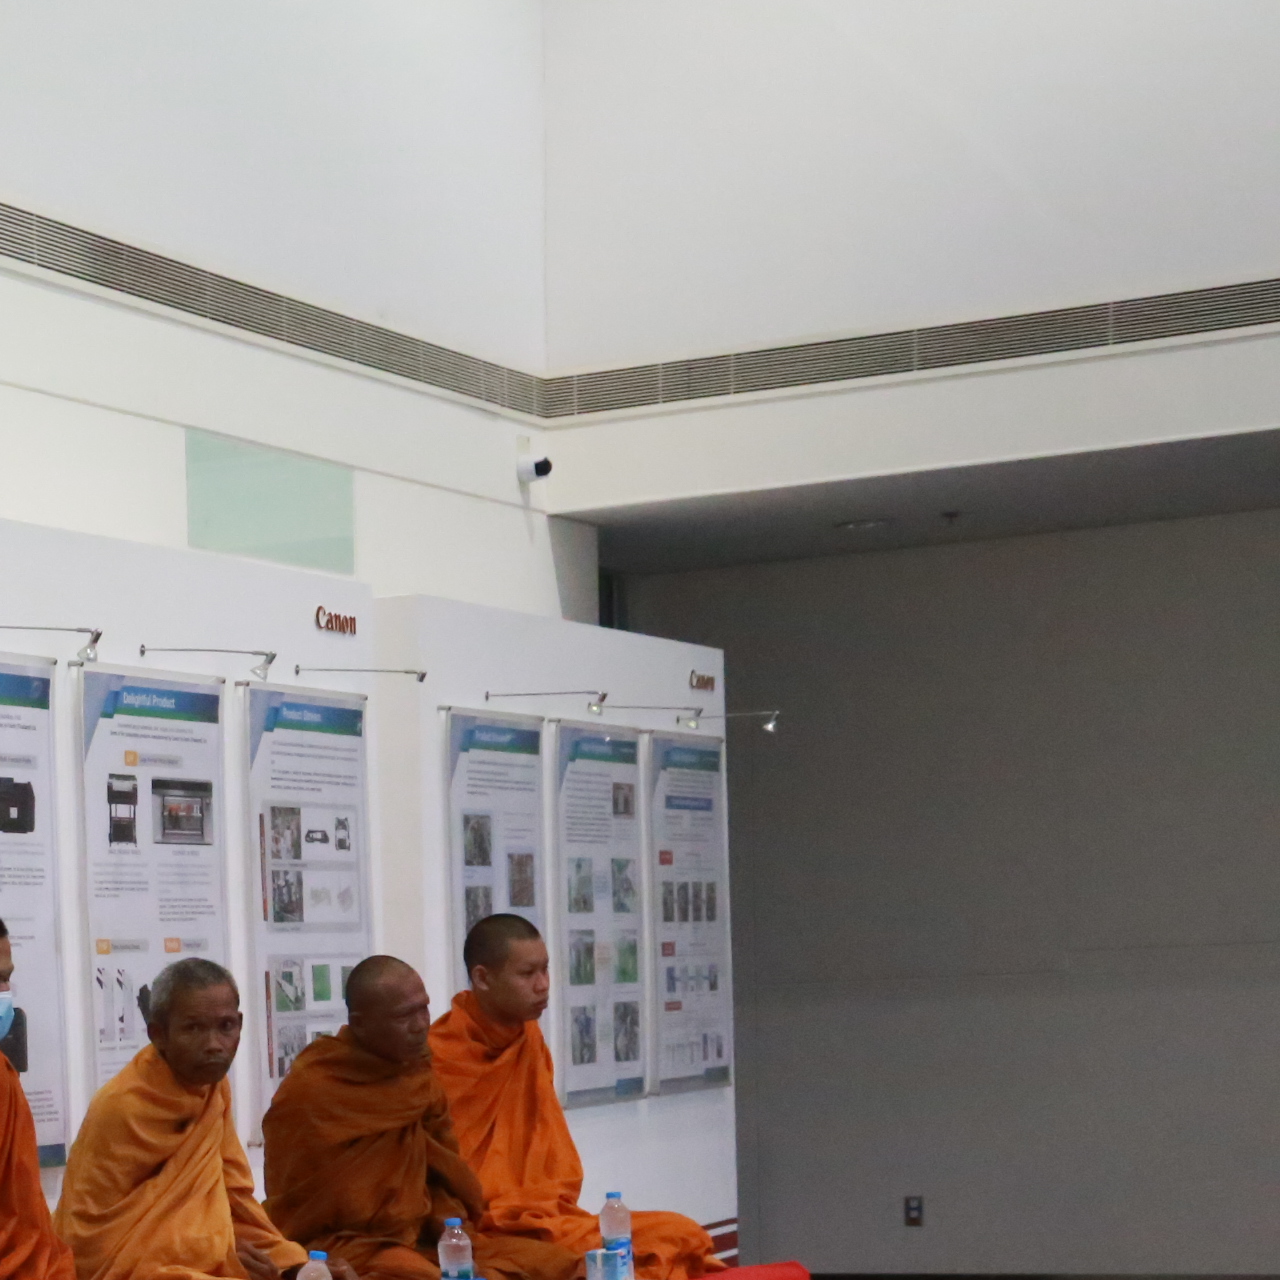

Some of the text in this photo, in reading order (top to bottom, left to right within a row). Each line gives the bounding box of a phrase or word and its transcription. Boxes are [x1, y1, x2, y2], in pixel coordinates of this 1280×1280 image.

[316, 606, 356, 634] Canon
[124, 692, 175, 708] Delightful Product
